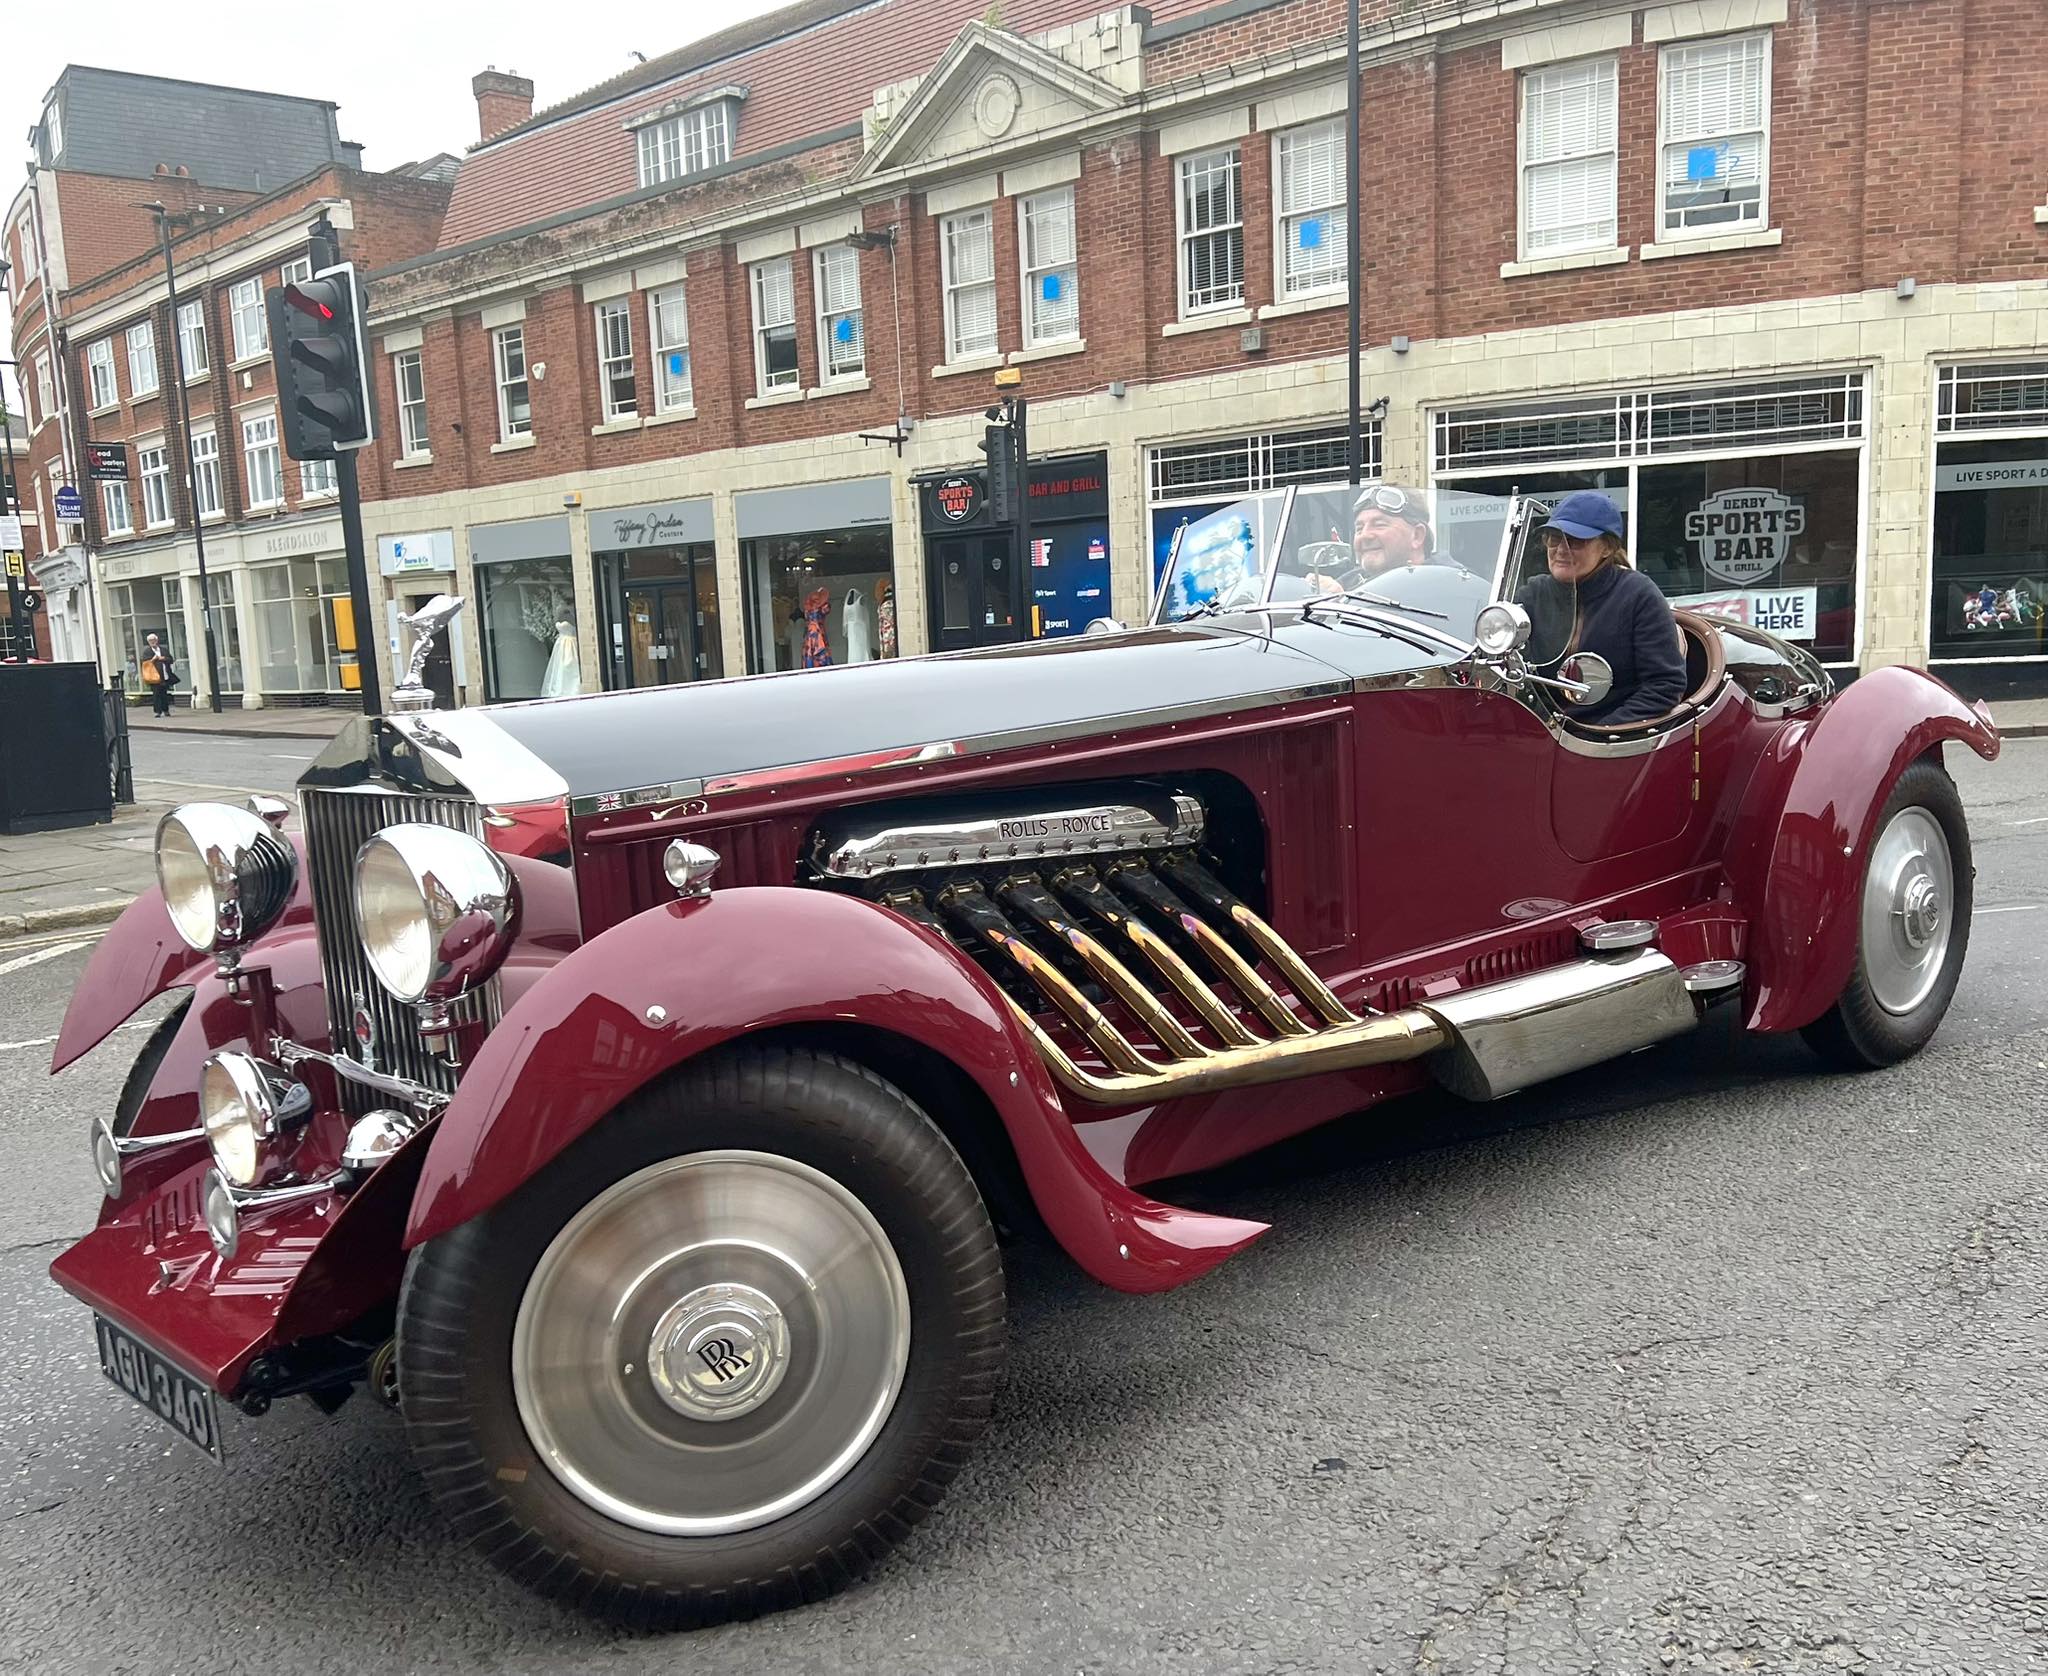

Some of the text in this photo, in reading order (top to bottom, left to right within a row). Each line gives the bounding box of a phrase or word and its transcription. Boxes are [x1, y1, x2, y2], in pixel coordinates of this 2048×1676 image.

[1956, 471, 1983, 482] LIVE
[1986, 469, 2026, 480] SPORT
[2029, 469, 2037, 478] A
[938, 486, 973, 500] SPORTS
[1028, 476, 1101, 496] BAR AND GRILL
[57, 504, 80, 512] STUART
[947, 498, 966, 511] BAR
[1450, 506, 1471, 516] LIVE
[1473, 502, 1506, 515] SPORT
[1723, 497, 1767, 510] DERBY
[614, 512, 683, 544] Tiffany Jordan
[1689, 509, 1801, 537] SPORTS
[1714, 537, 1774, 561] BAR
[9, 555, 22, 574] H
[1725, 563, 1763, 572] & GRILL
[1755, 596, 1804, 614] LIVE
[1755, 614, 1804, 630] HERE
[1001, 820, 1048, 838] ROLLS
[1062, 815, 1109, 833] ROYCE
[104, 1326, 209, 1446] AGU 340
